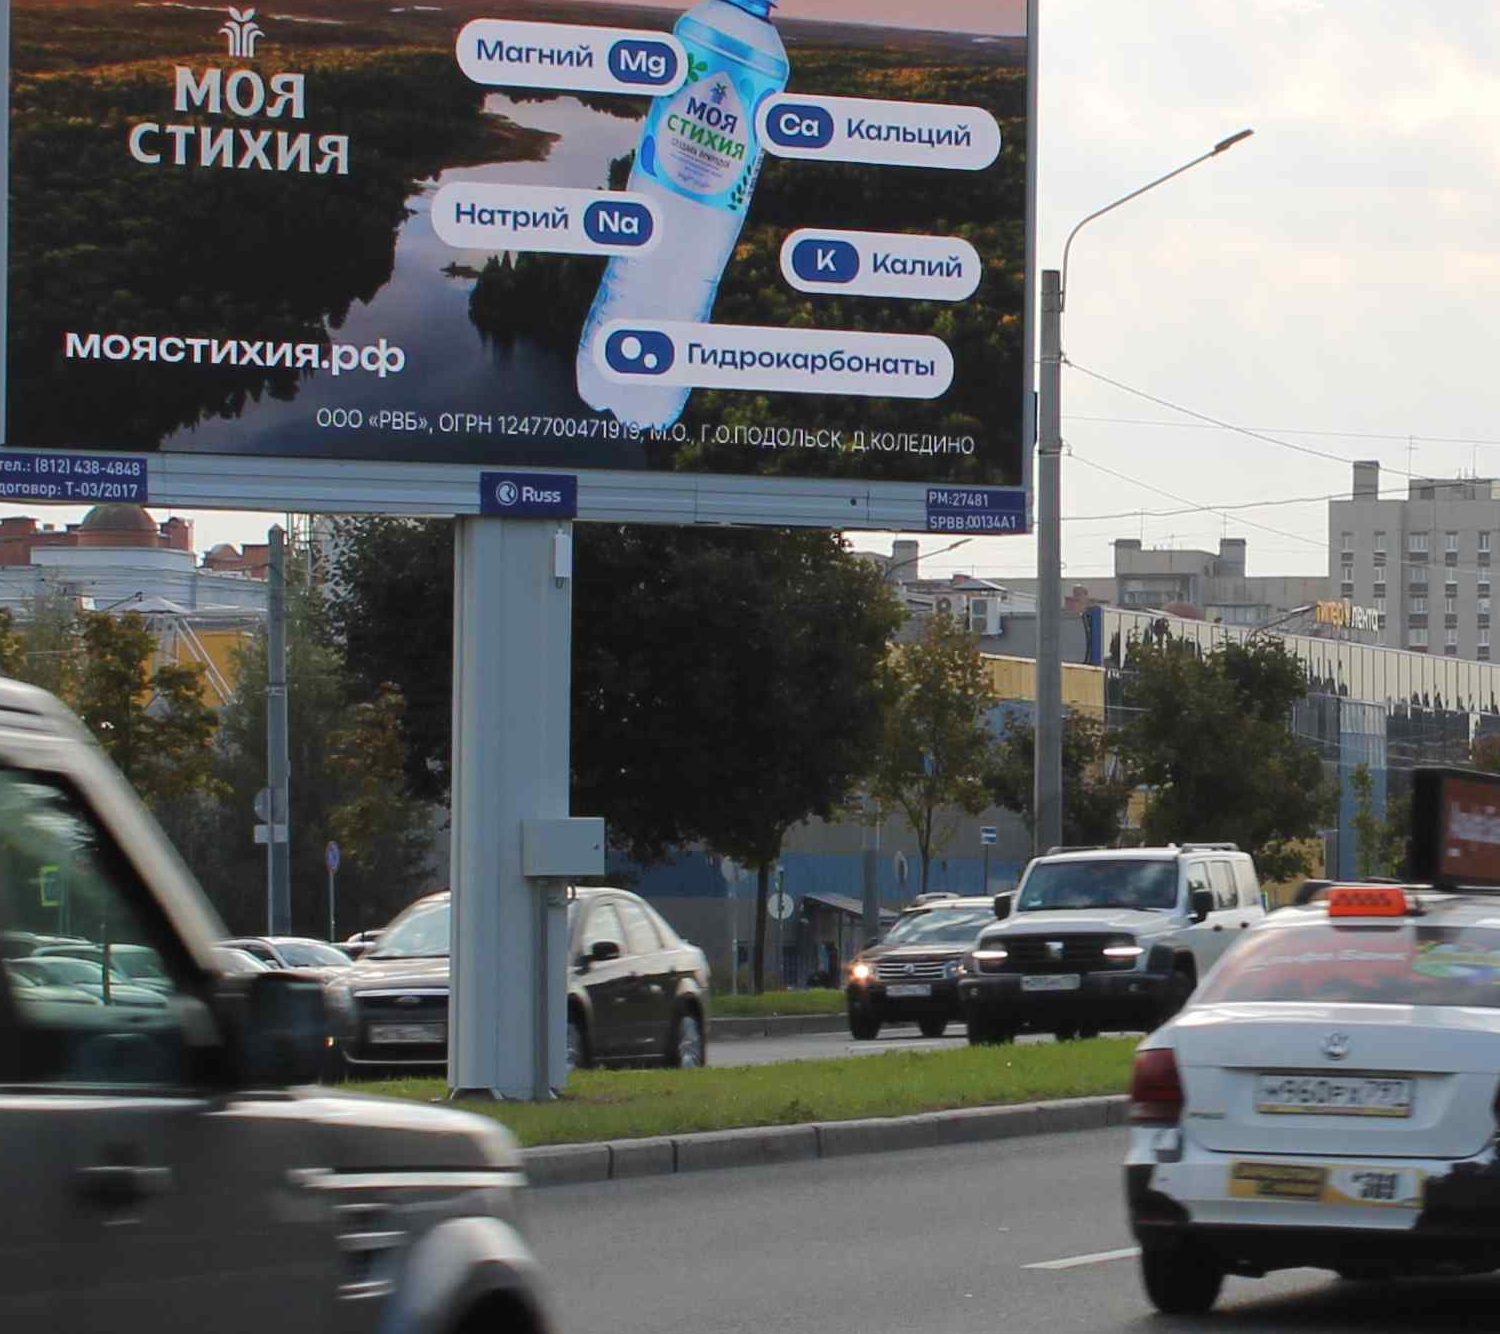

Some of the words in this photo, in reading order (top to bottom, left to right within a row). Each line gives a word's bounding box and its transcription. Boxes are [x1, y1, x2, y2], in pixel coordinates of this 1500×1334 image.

[476, 38, 594, 68] Магний
[619, 48, 666, 77] Mg
[174, 65, 306, 119] МОЯ
[686, 96, 738, 134] МОЯ
[779, 113, 820, 137] Ca
[667, 114, 746, 160] СТИХИЯ
[847, 118, 972, 148] Кальций
[128, 122, 350, 176] СТИХИЯ
[455, 202, 569, 230] Натрий
[598, 210, 639, 235] Na
[873, 252, 963, 278] Калий
[65, 331, 406, 378] моястихия.рф
[687, 342, 935, 376] Гидрокарбонаты
[316, 408, 363, 428] ООО
[439, 413, 492, 434] ОГРН
[35, 457, 70, 474] (812)
[74, 460, 140, 476] 438-4848
[521, 486, 562, 503] Russ
